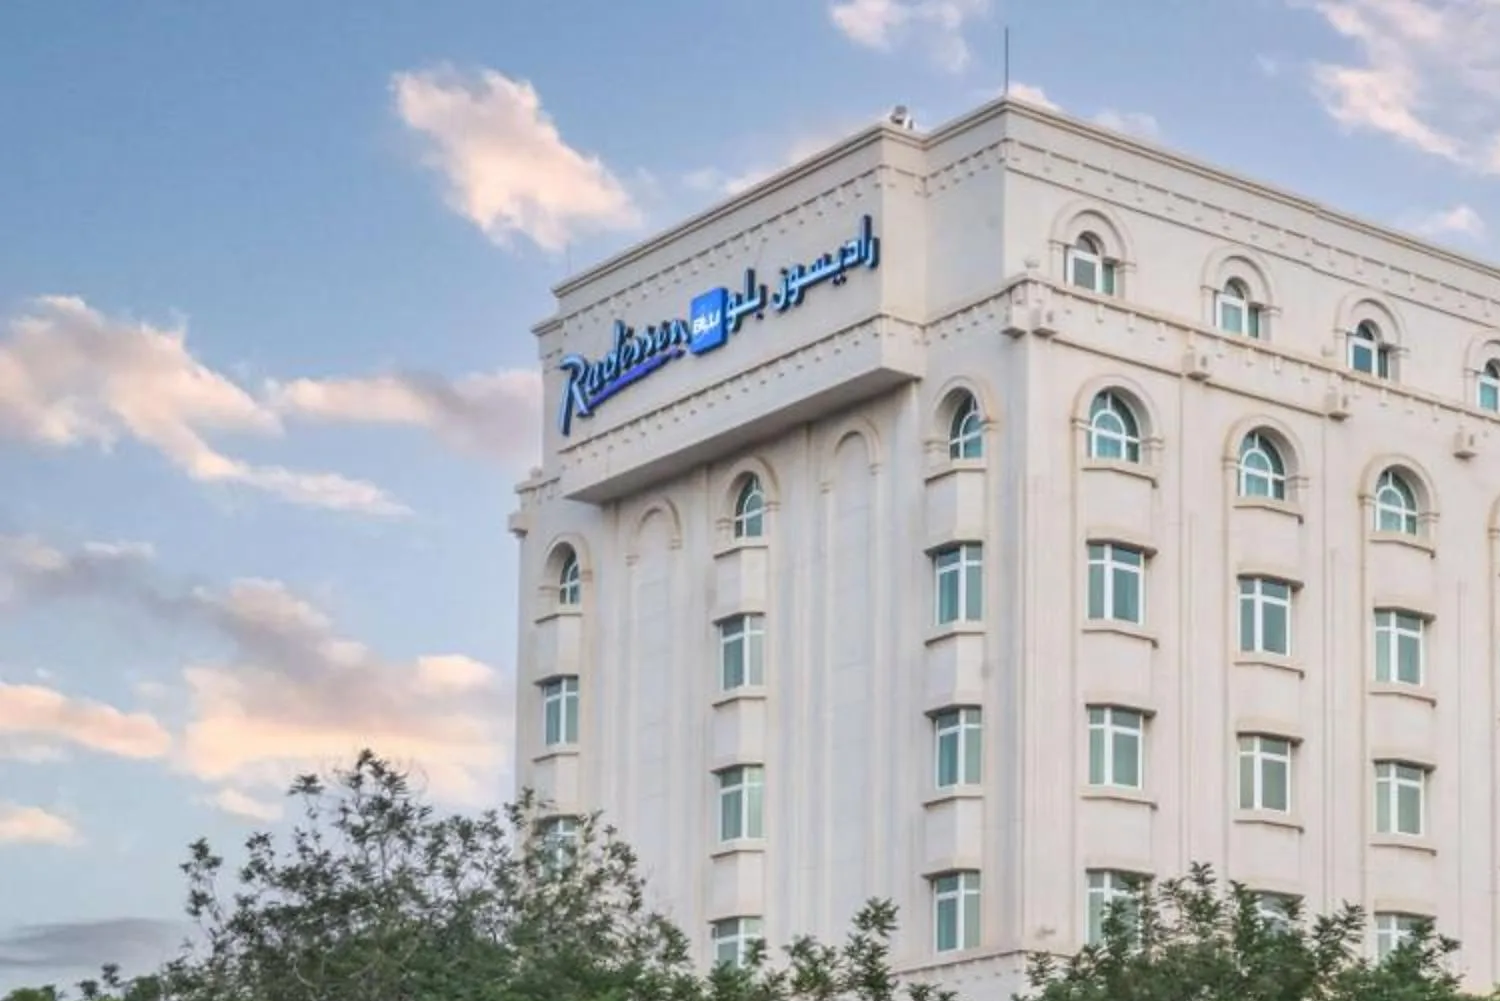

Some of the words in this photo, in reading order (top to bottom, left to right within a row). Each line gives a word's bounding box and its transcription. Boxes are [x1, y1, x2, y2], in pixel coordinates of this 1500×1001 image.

[726, 268, 768, 334] بلو
[771, 214, 881, 314] راديسون
[559, 318, 692, 437] Radisson
